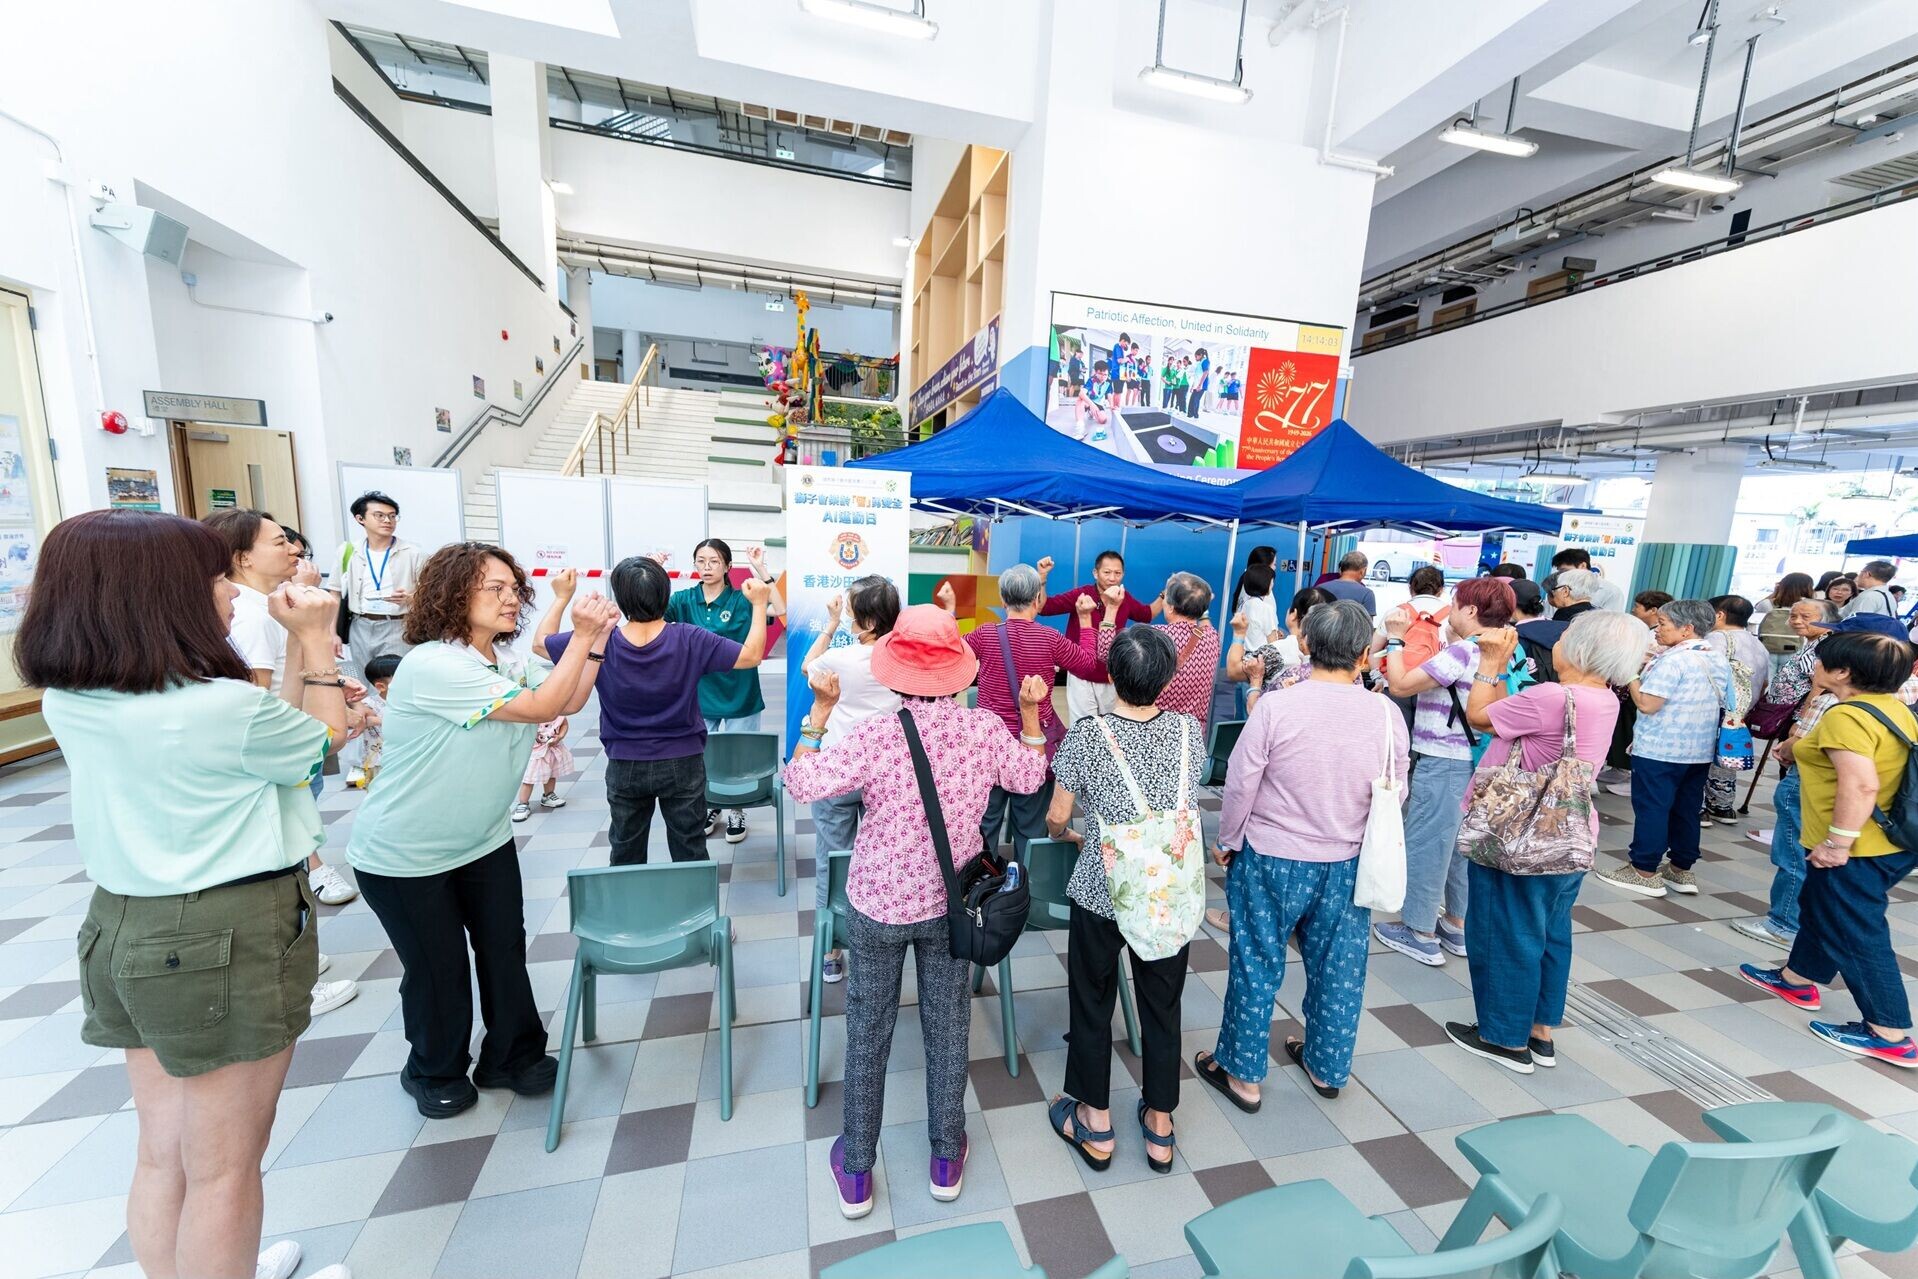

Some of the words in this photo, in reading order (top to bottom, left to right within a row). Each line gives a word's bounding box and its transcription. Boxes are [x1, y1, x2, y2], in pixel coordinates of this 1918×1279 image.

[101, 184, 117, 199] PA
[1086, 307, 1129, 323] Patriotic
[1131, 311, 1177, 329] Affection,
[1180, 318, 1212, 333] United
[1214, 322, 1224, 334] in
[1225, 324, 1270, 340] Solidarity
[151, 396, 201, 408] ASSEMBLY
[204, 400, 228, 410] HALL
[1282, 378, 1330, 428] 77
